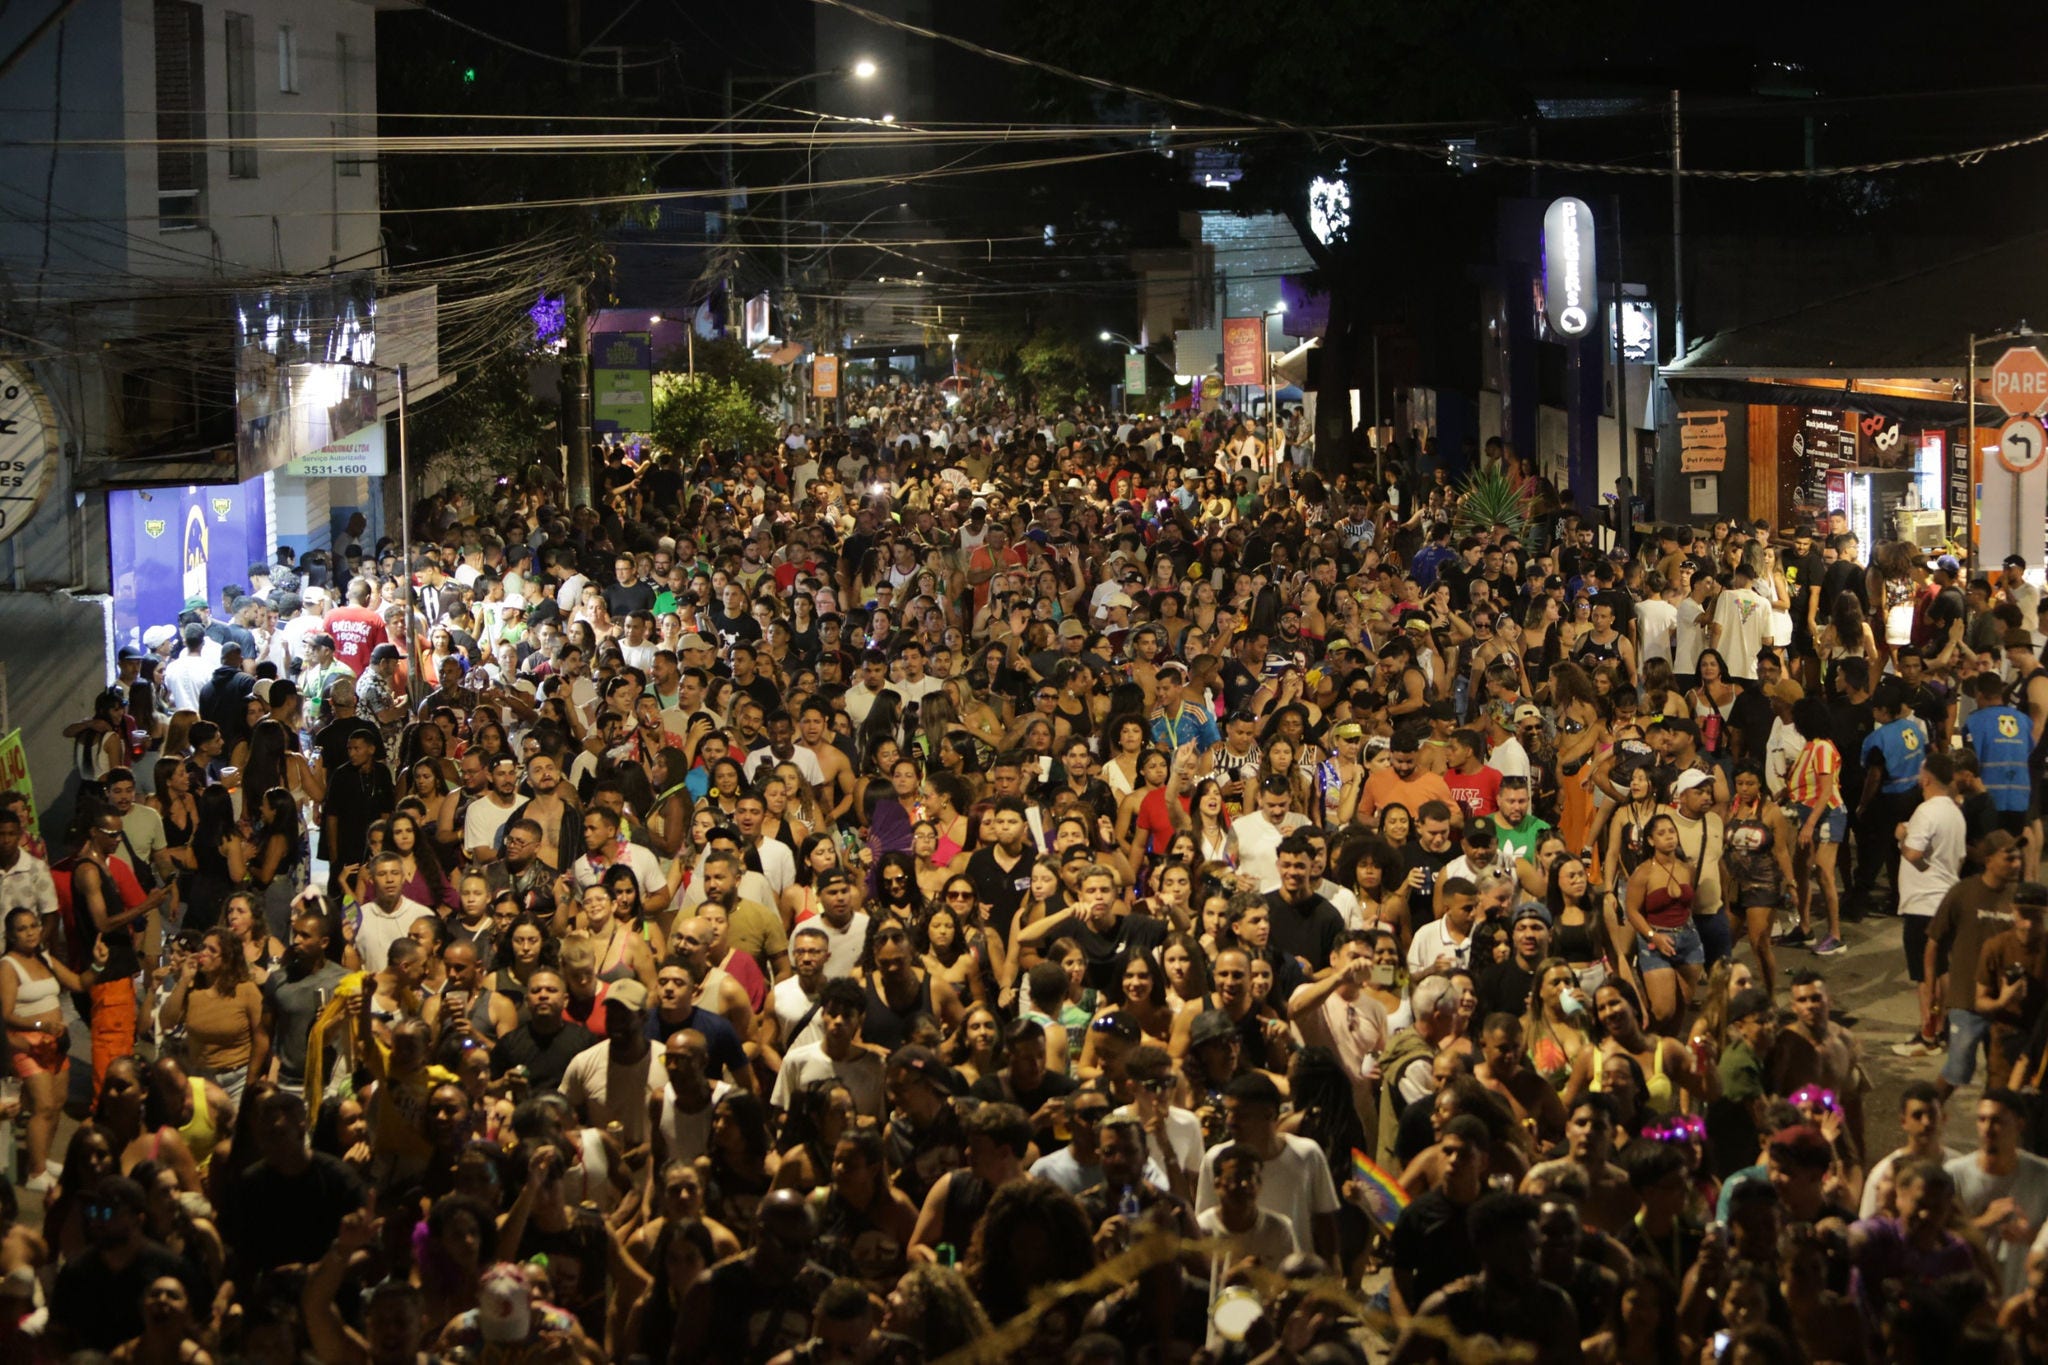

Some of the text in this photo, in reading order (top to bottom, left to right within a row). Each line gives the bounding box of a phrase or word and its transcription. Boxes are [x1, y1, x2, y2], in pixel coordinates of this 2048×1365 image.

[1561, 202, 1581, 307] BURGERS
[1997, 371, 2047, 395] PARE
[303, 465, 367, 474] 3531-1600
